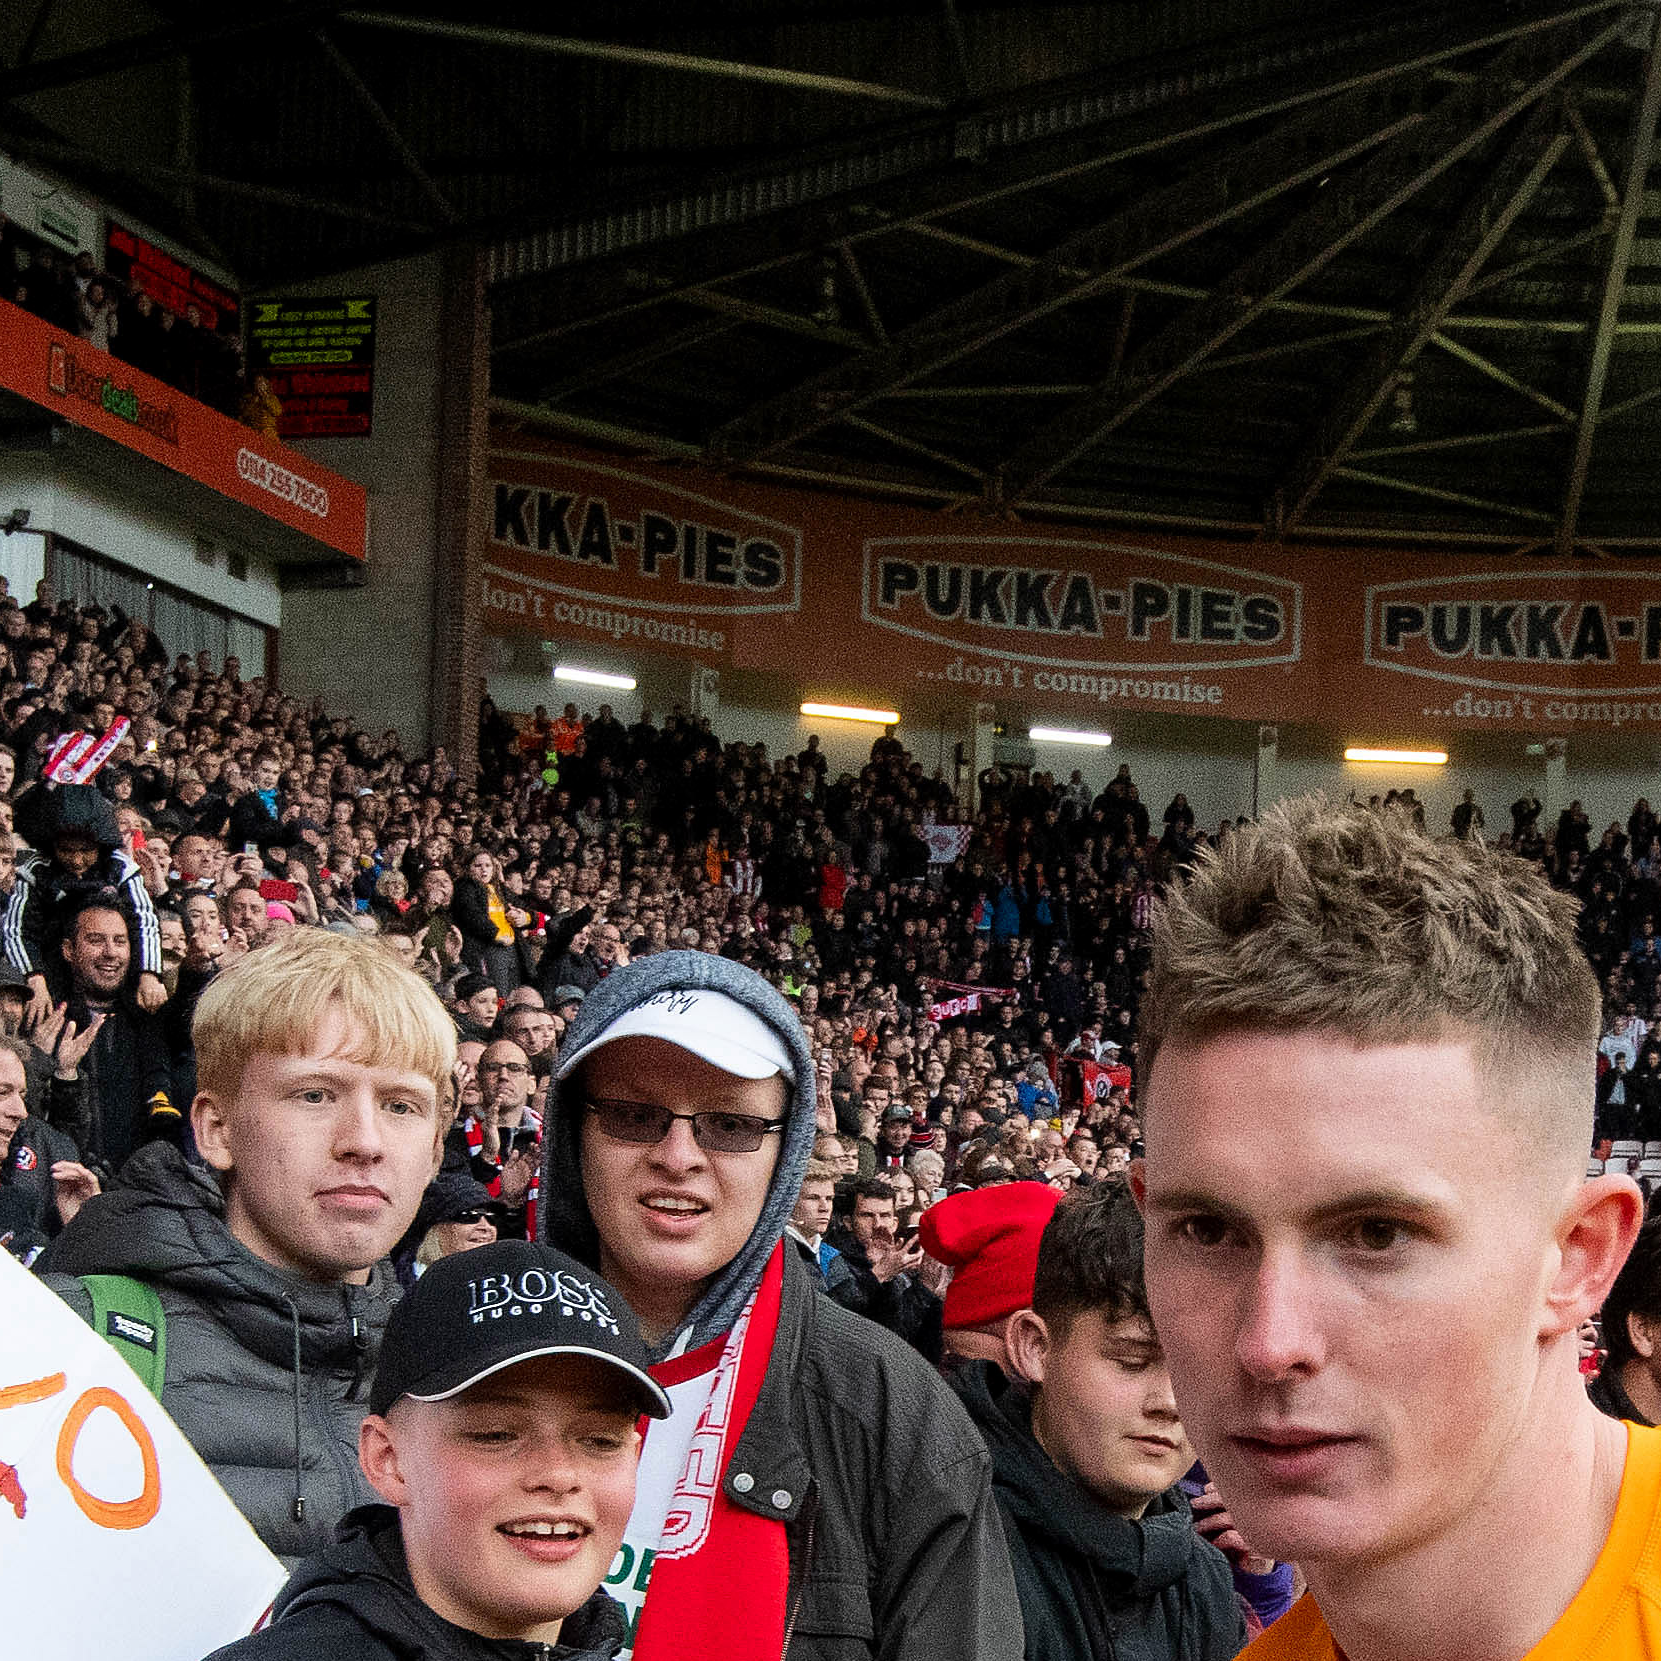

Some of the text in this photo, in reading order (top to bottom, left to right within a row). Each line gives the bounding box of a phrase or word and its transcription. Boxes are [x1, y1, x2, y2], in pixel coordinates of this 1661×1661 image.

[553, 601, 726, 652] compromise
[878, 556, 1285, 647] PUKKA-PIES
[1034, 671, 1224, 705] compromise
[468, 1267, 617, 1323] BOSS
[473, 1303, 620, 1336] HUGO BOSS
